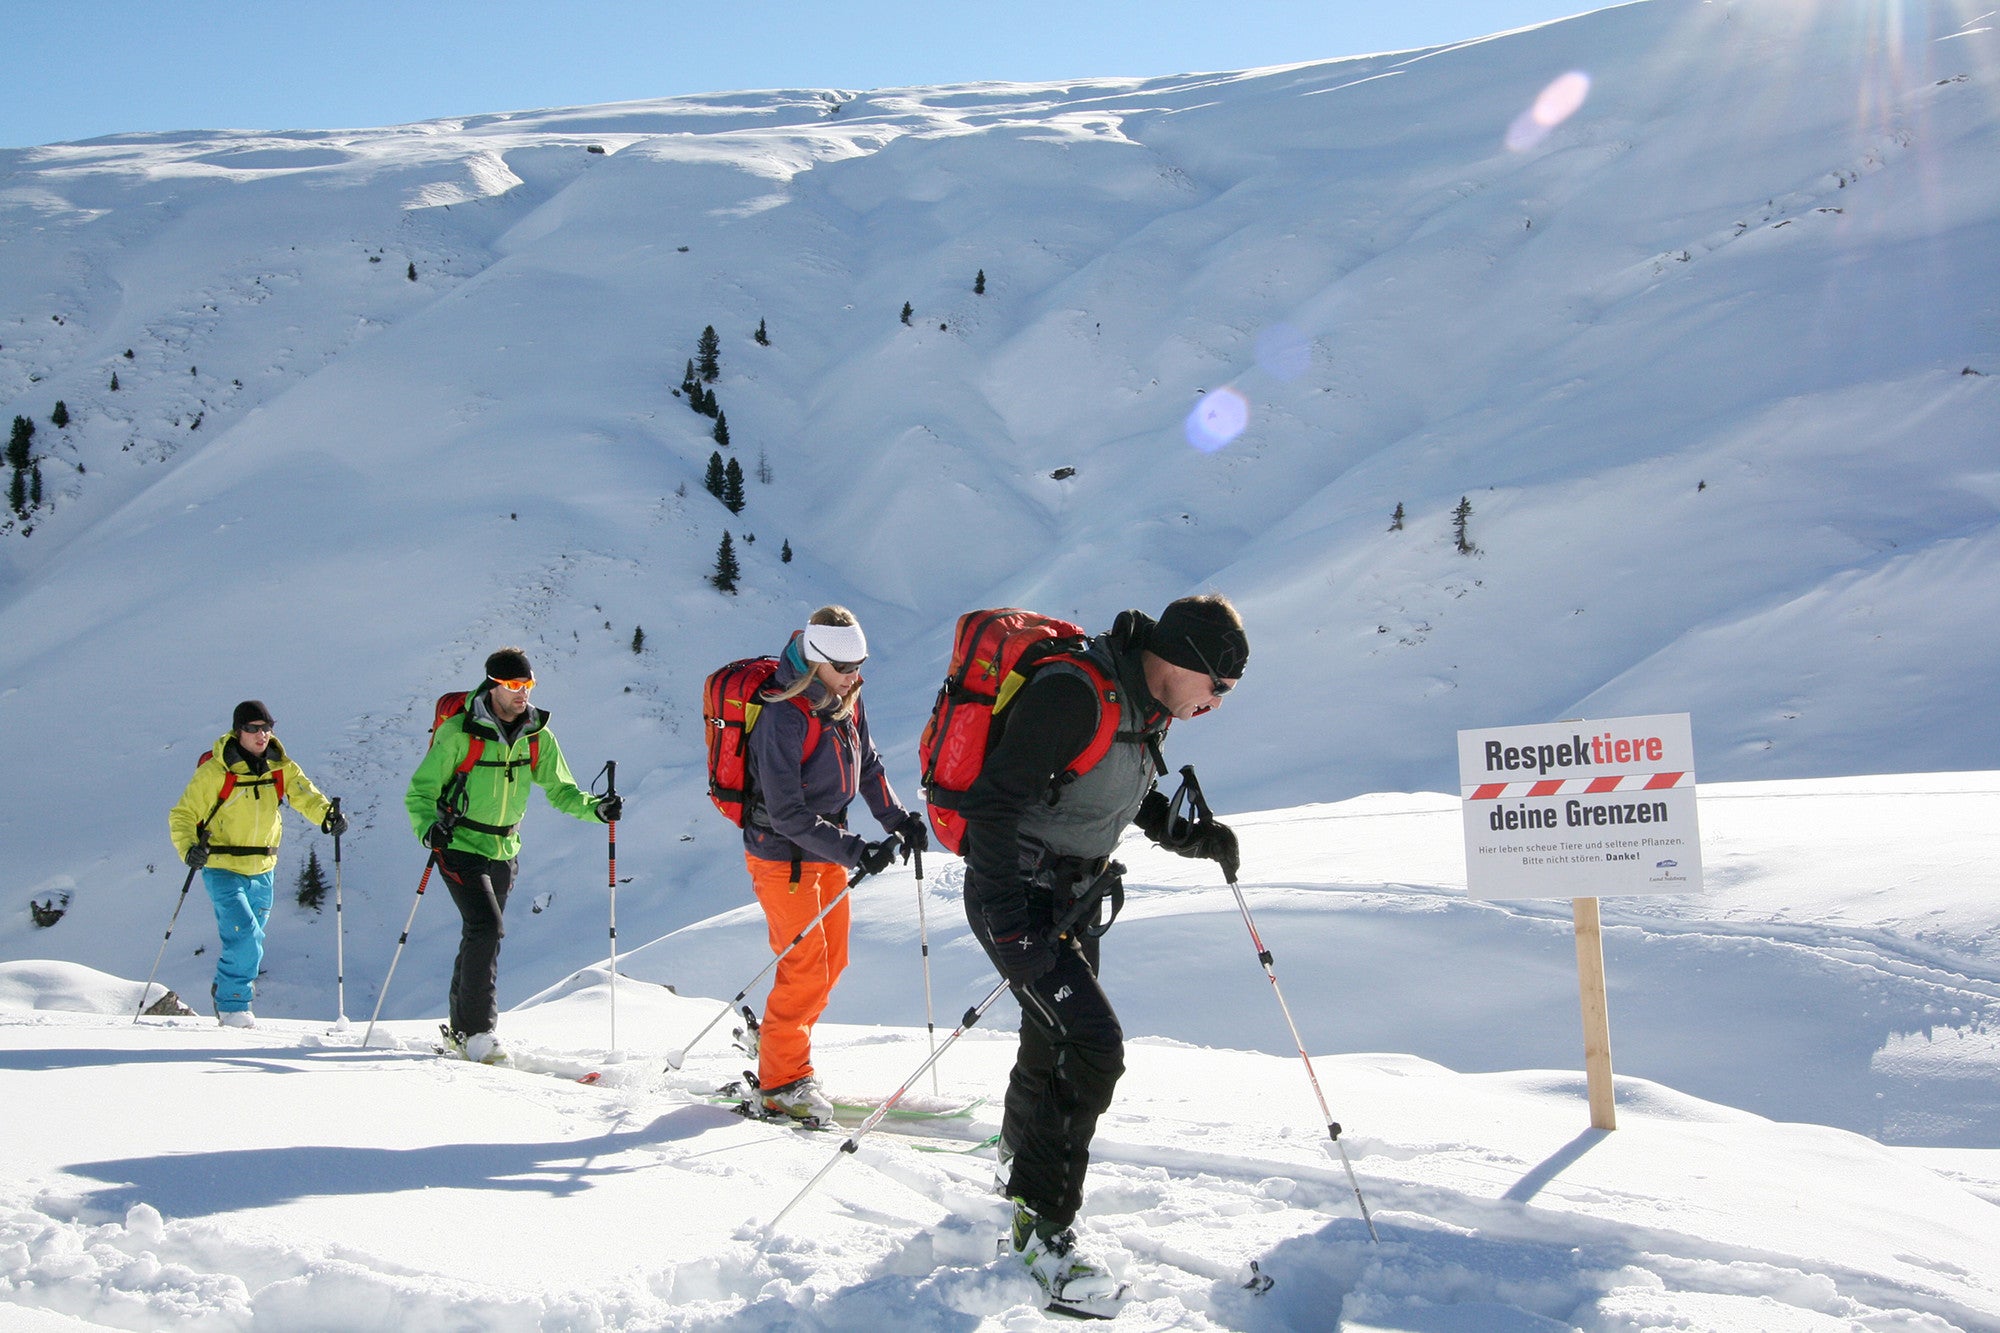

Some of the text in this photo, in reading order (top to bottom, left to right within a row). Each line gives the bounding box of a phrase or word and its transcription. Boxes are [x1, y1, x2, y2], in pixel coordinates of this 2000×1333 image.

[1485, 732, 1663, 775] Respektiere
[1489, 799, 1668, 831] deine Grenzen
[1479, 837, 1685, 854] Hier leben scheue Tiere und seltene Pflanzen.
[1522, 852, 1641, 865] Bitte nicht stören. Danke!
